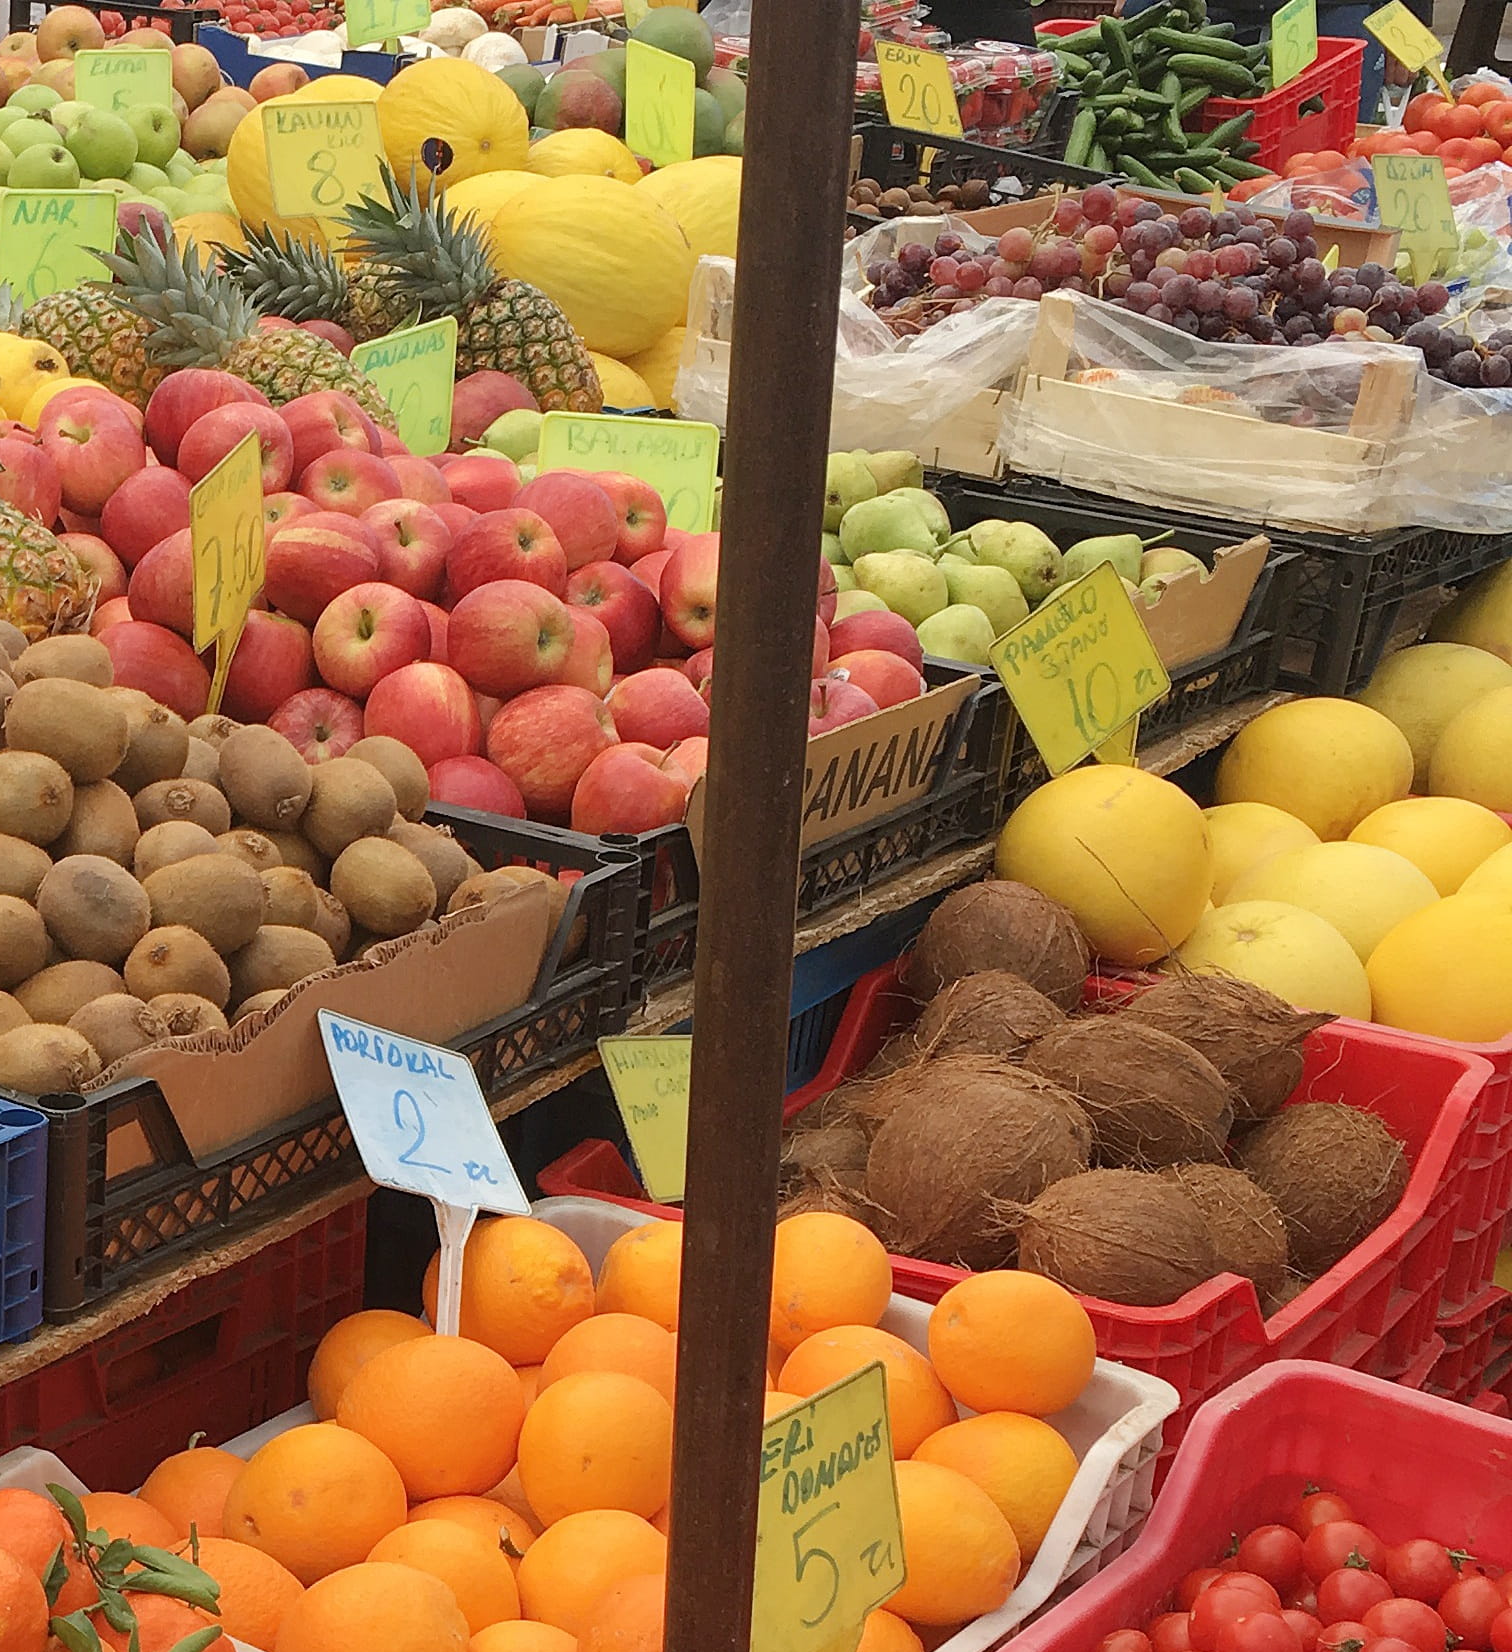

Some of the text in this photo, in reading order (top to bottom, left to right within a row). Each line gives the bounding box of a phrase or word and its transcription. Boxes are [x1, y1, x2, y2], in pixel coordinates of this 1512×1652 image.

[899, 73, 941, 126] 20
[306, 149, 346, 206] 8
[1394, 188, 1433, 233] 20
[26, 232, 58, 301] 6
[1067, 661, 1122, 744] 10
[391, 1088, 453, 1175] 2
[792, 1501, 840, 1629] 5
